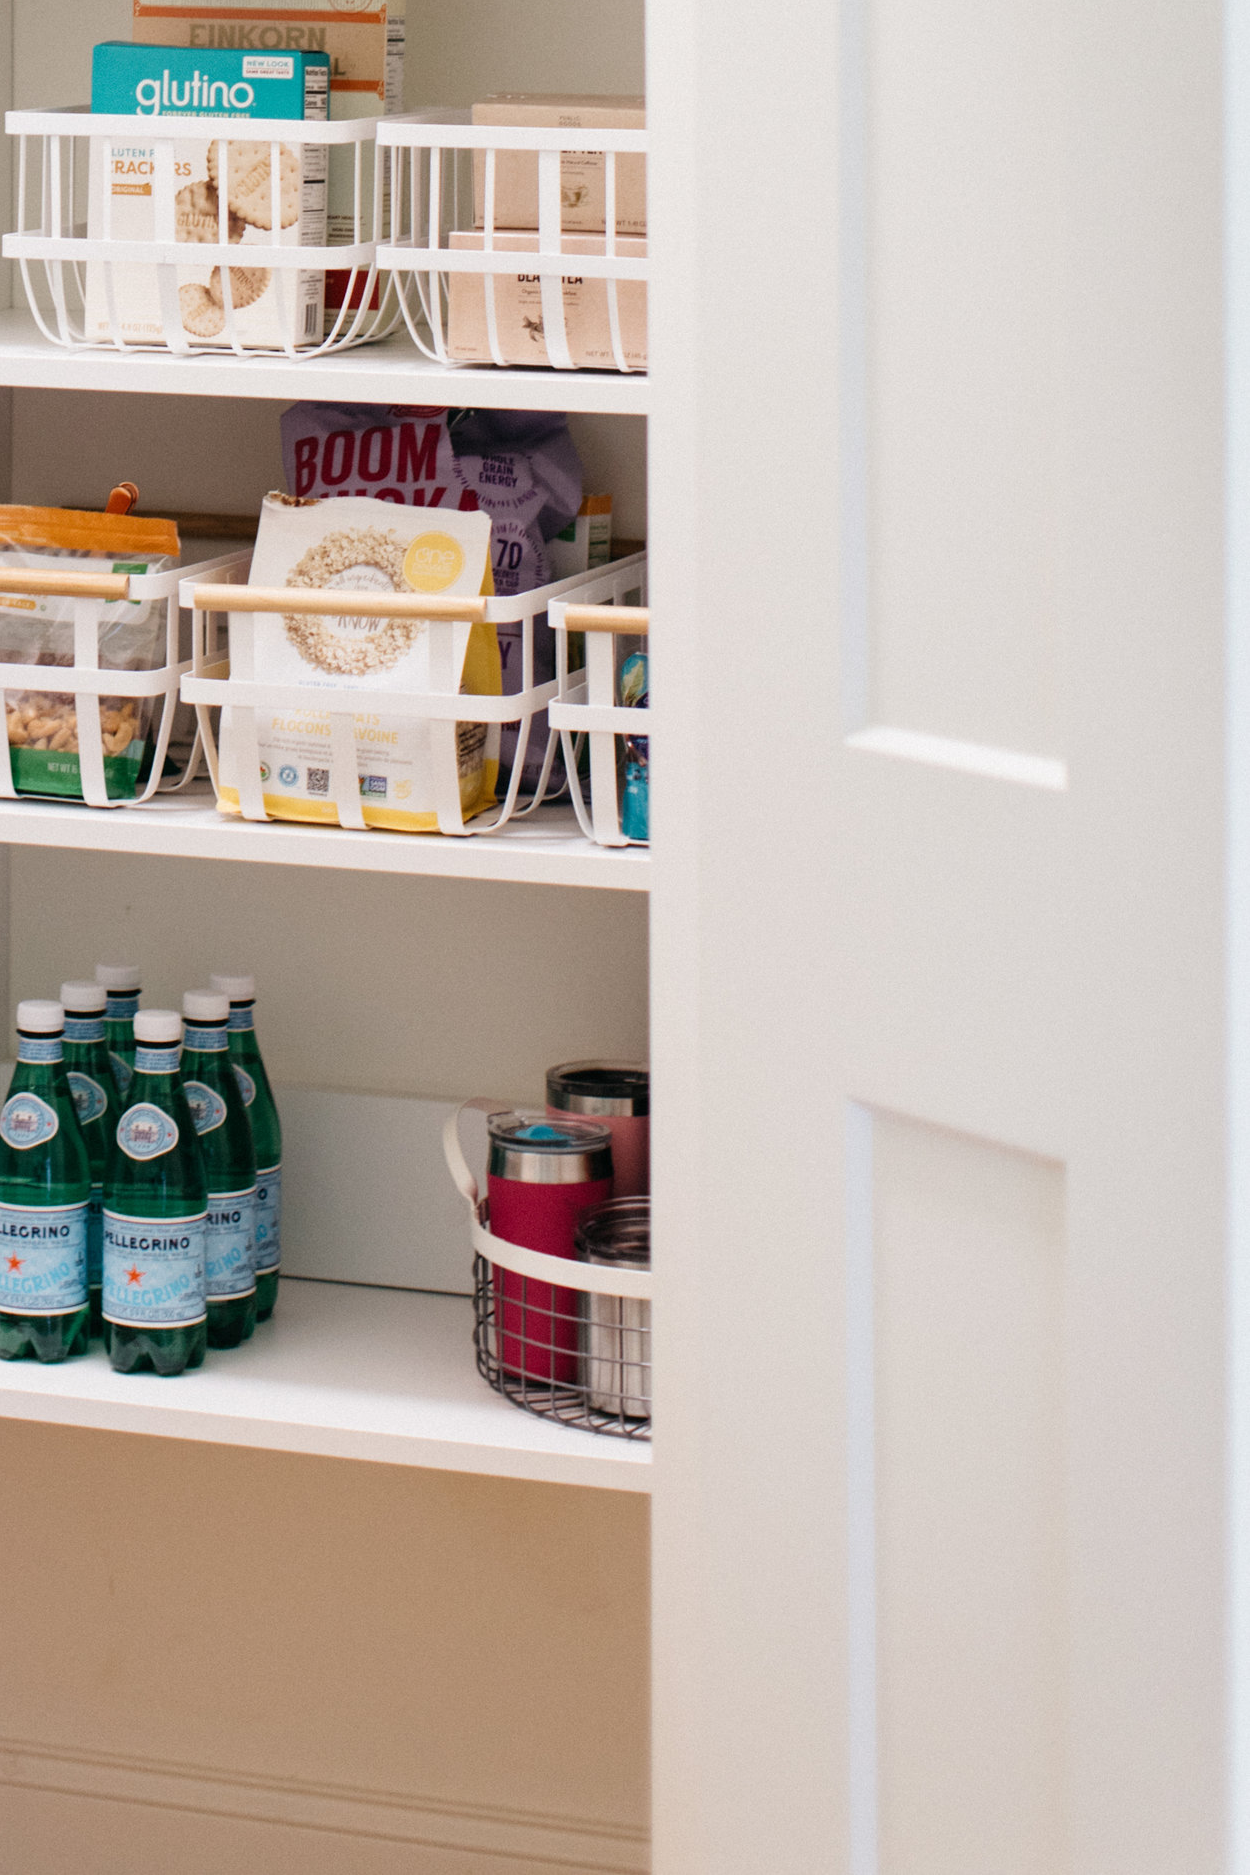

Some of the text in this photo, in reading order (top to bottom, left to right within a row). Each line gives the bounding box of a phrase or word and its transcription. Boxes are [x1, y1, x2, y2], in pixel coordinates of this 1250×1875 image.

[189, 23, 327, 51] EINKORN
[246, 60, 265, 68] NEW
[135, 69, 255, 117] glutino
[111, 148, 149, 158] LUTEN
[294, 422, 442, 498] BOOM
[482, 461, 514, 476] GRAIN
[478, 471, 518, 488] ENERGY
[414, 547, 456, 565] one
[496, 538, 523, 570] 70
[271, 717, 332, 737] FLOCONS
[352, 712, 380, 725] ATS
[104, 1230, 191, 1252] PELLEGRINO
